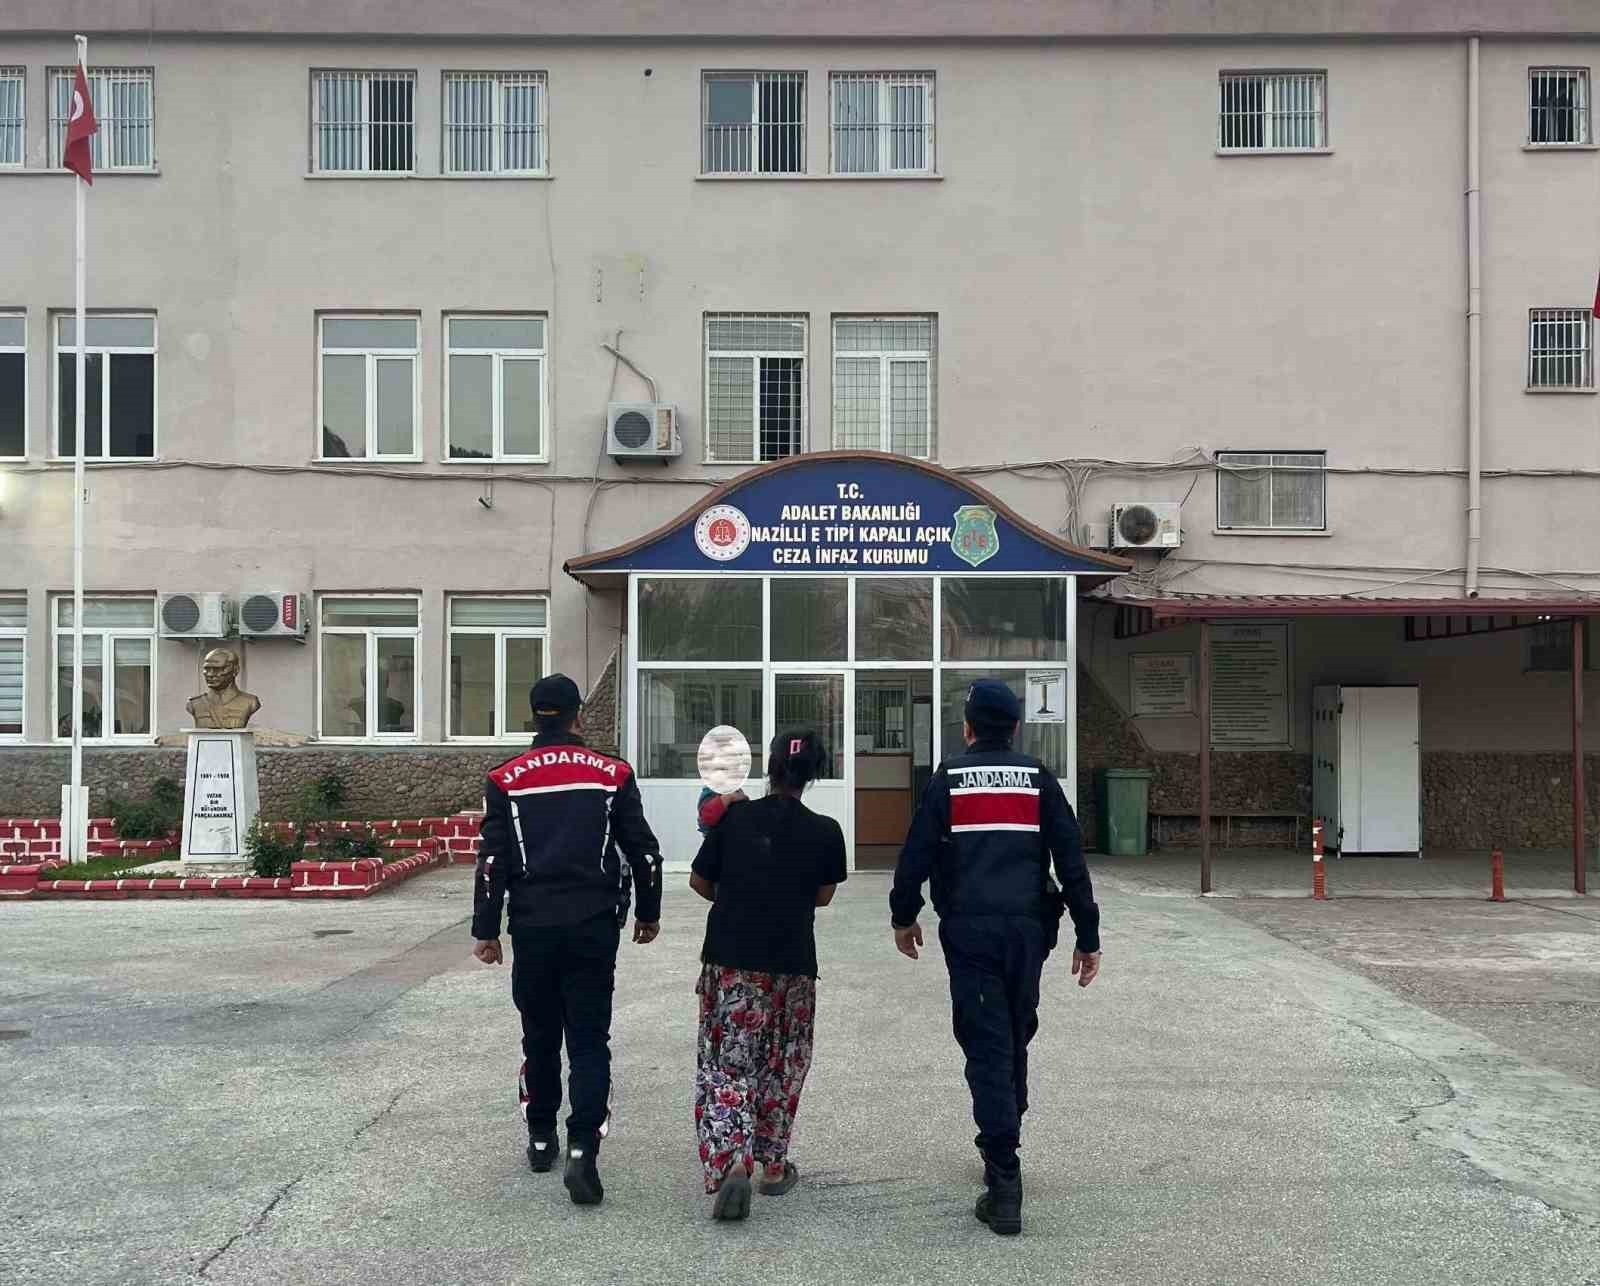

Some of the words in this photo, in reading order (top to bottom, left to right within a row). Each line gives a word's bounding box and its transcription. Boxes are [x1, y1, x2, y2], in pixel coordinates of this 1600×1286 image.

[836, 483, 864, 499] T.C.
[781, 504, 838, 521] ADALET
[841, 502, 921, 521] BAKANLIĞI
[751, 523, 807, 542] NAZİLLİ
[811, 526, 820, 542] E
[824, 523, 854, 542] TİPİ
[859, 526, 911, 542] KAPALI
[915, 526, 951, 546] AÇIK
[772, 548, 812, 564] CEZA
[815, 545, 858, 564] İNFAZ
[862, 548, 929, 564] KURUMU
[502, 751, 618, 784] JANDARMA
[959, 772, 1033, 788] JANDARMA
